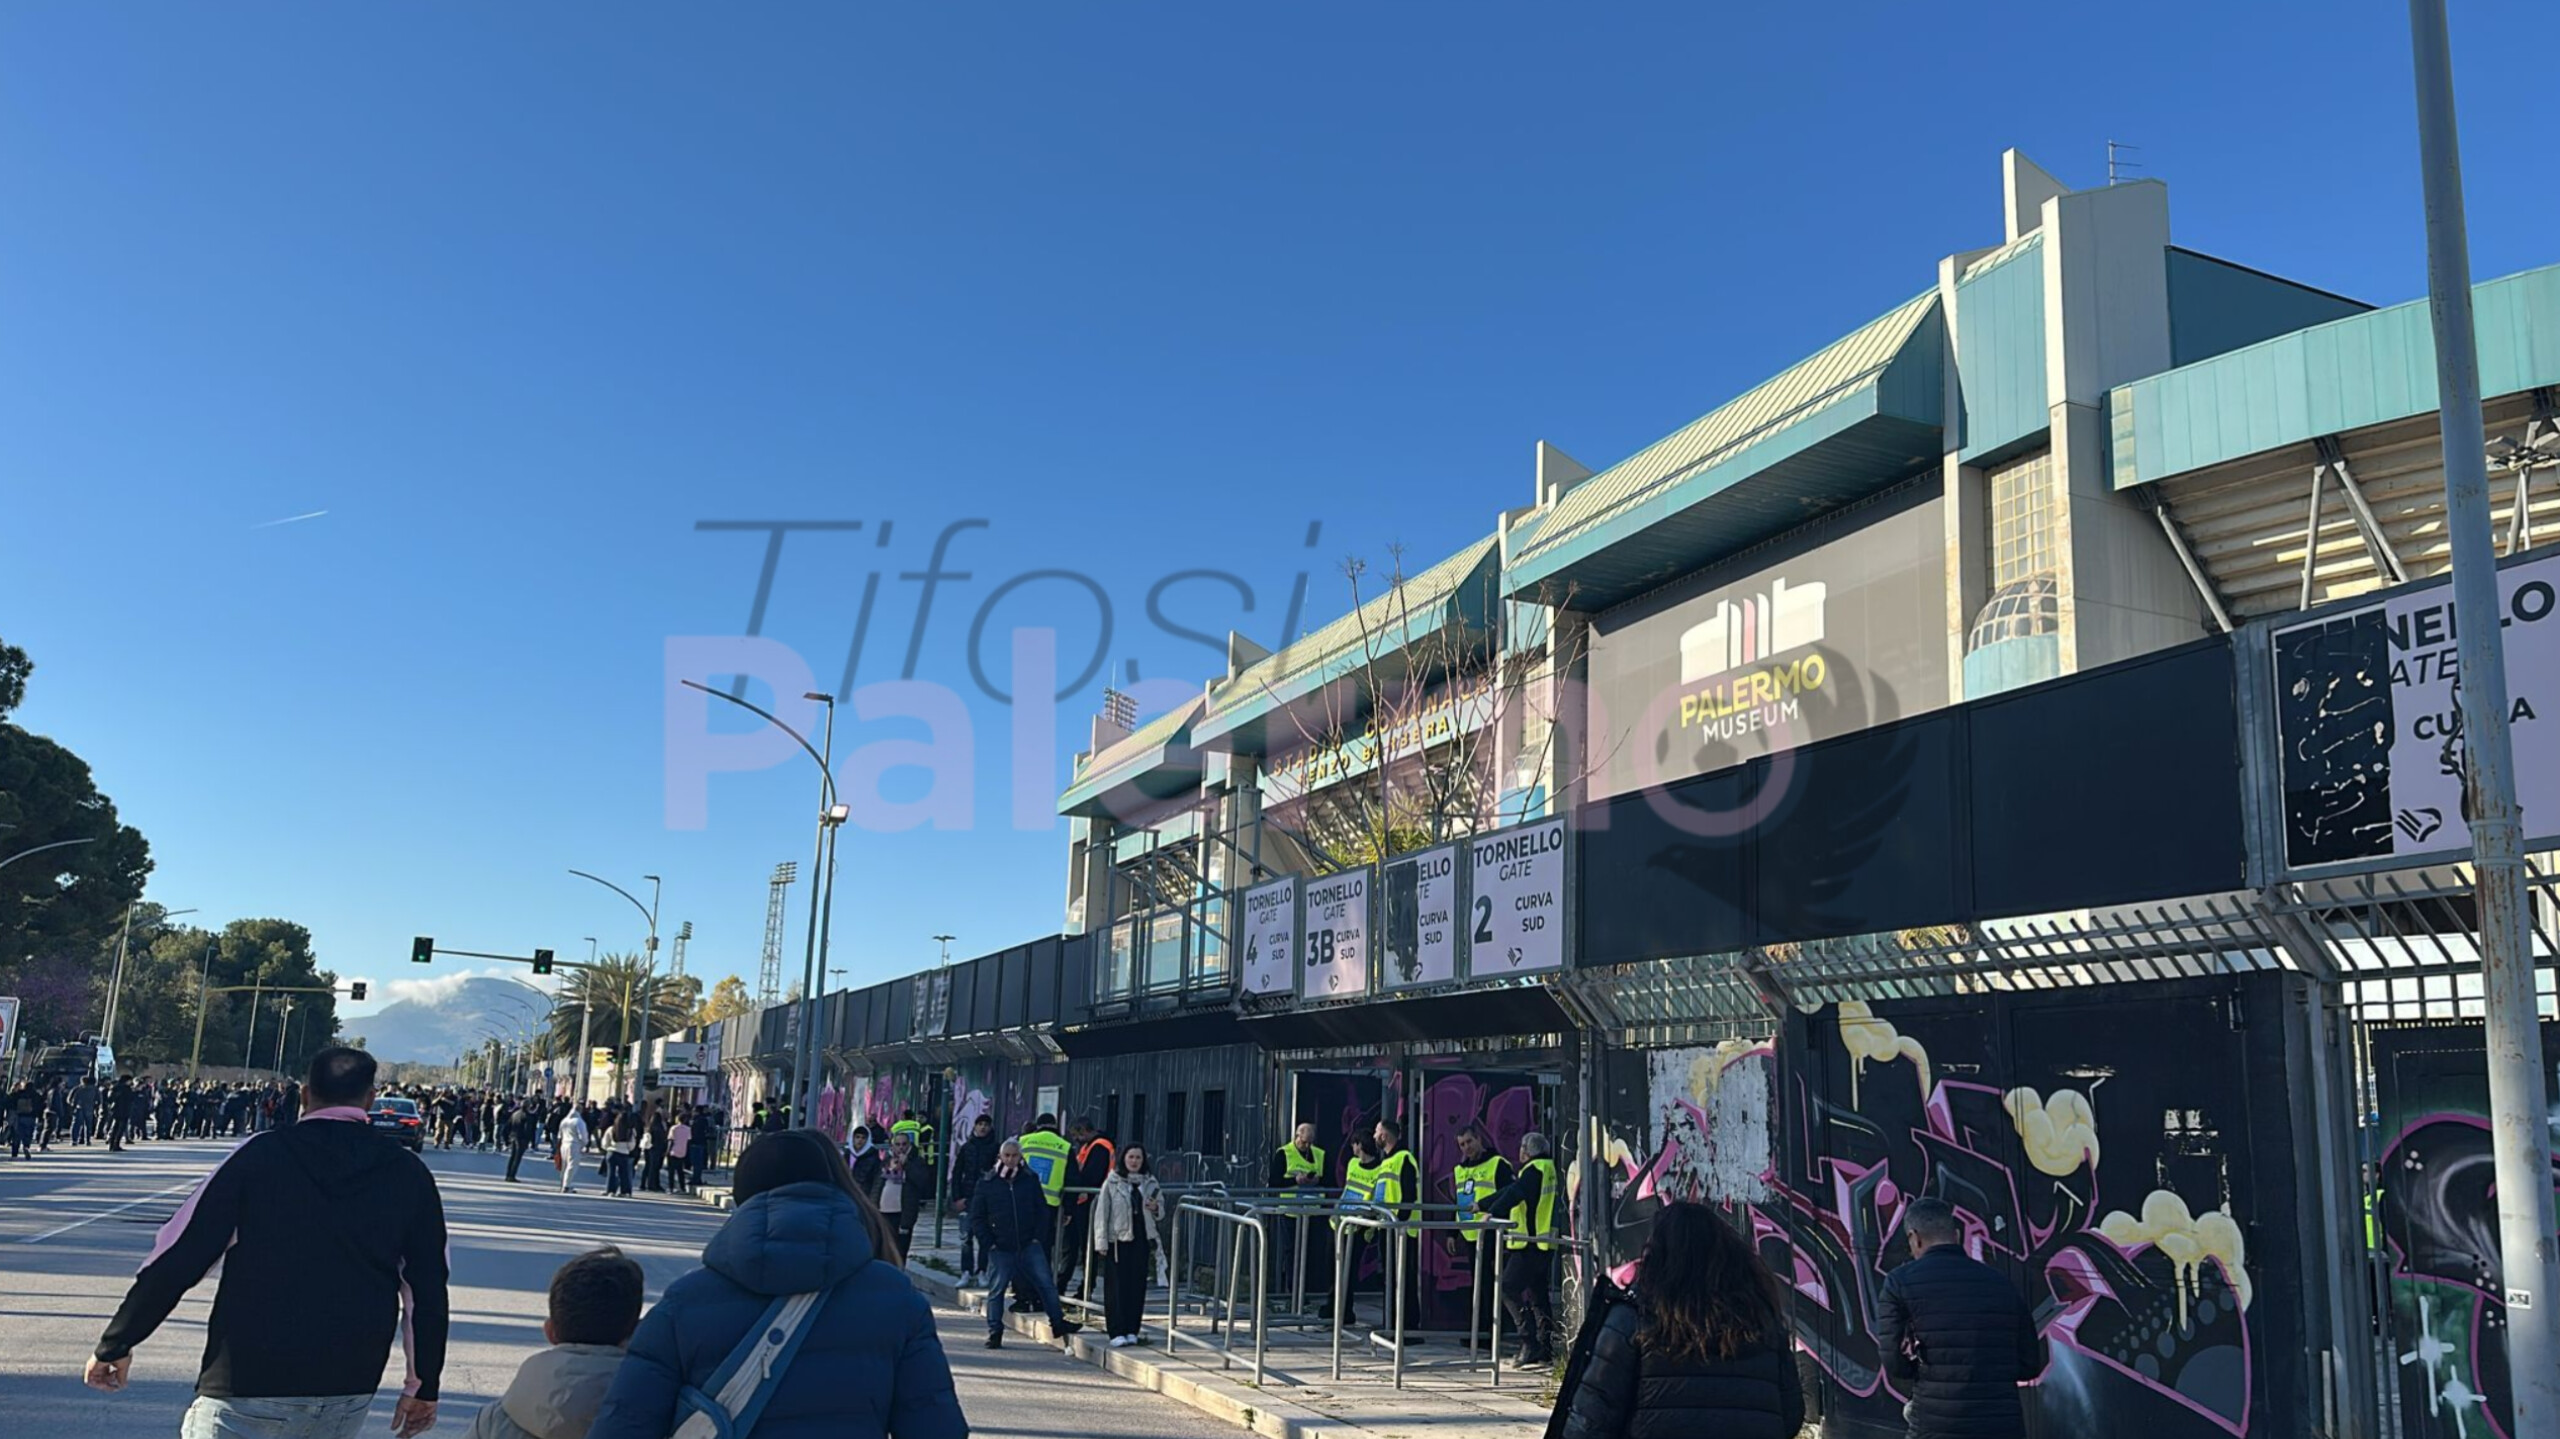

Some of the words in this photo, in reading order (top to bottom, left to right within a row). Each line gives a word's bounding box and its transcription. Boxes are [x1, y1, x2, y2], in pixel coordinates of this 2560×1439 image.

[1681, 653, 1826, 728] PALERMO
[1703, 697, 1799, 744] MUSEUM
[2413, 697, 2536, 741] CUA
[1474, 827, 1562, 868] TORNELLO
[1499, 858, 1533, 882] GATE
[1248, 886, 1292, 913] TORNELLO
[1308, 879, 1363, 909] TORNELLO
[1515, 891, 1554, 912] CURVA
[1259, 907, 1279, 925] GATE
[1324, 902, 1347, 921] GATE
[1419, 909, 1449, 928] CURVA
[1474, 895, 1493, 945] 2
[1336, 927, 1361, 943] CURVA
[1522, 915, 1545, 933] SUD
[1269, 931, 1289, 946] CURVA
[1306, 928, 1335, 968] 3B
[1425, 930, 1442, 946] SUD
[1246, 933, 1258, 966] 4
[1271, 948, 1286, 961] SUD
[1340, 946, 1356, 960] SUD
